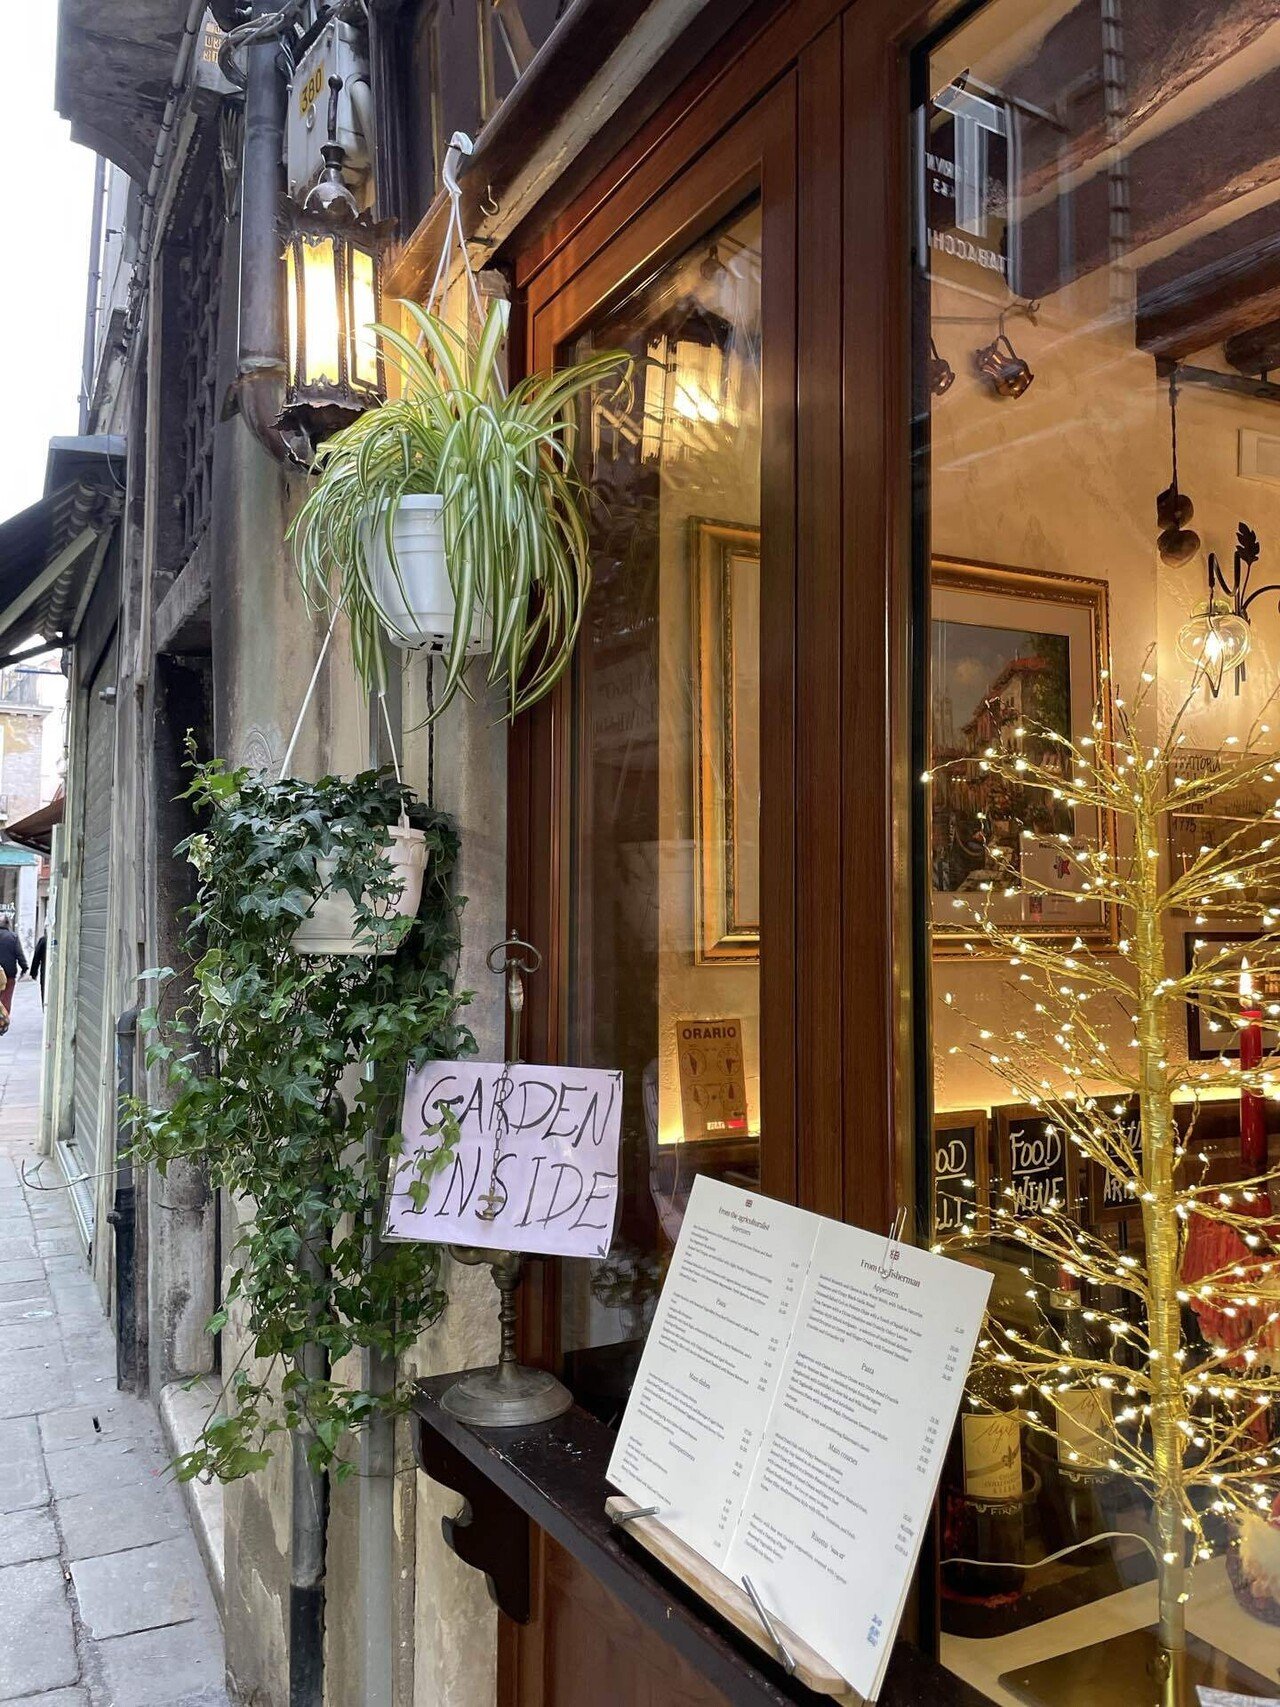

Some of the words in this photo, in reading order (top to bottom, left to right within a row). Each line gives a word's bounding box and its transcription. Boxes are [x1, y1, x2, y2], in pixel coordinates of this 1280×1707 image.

[301, 67, 324, 113] 380
[682, 1026, 737, 1040] ORARIO
[421, 1076, 615, 1148] GARDEN
[401, 1147, 618, 1231] INSIDE
[860, 1259, 878, 1272] From
[888, 1267, 921, 1288] fisherman
[873, 1282, 899, 1299] Appetizers
[861, 1362, 875, 1375] Pasta
